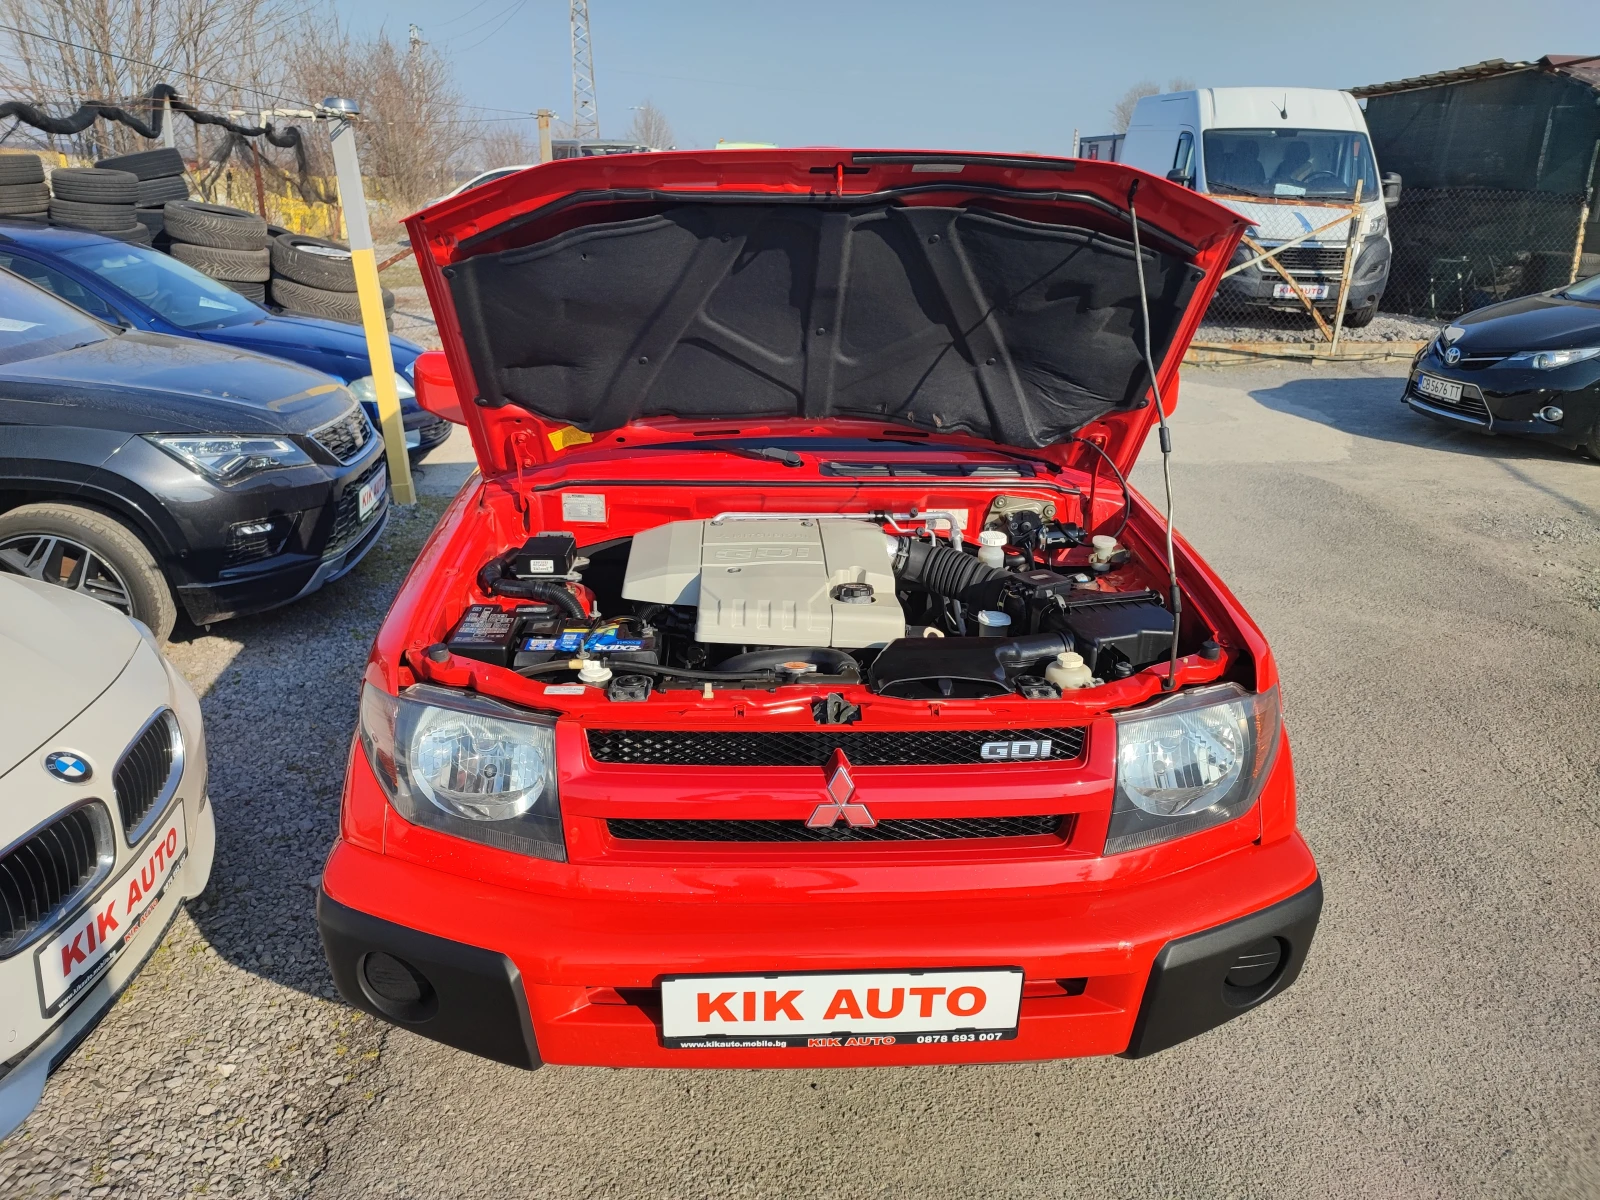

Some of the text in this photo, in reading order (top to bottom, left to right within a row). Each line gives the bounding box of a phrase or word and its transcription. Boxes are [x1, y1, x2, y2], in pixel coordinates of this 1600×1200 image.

[1421, 377, 1431, 391] CB
[1430, 380, 1448, 396] 5676
[1449, 384, 1461, 399] TT
[715, 546, 810, 560] GDI
[981, 740, 1052, 759] GDI
[60, 899, 119, 978] KIK
[126, 827, 177, 916] AUTO
[697, 986, 988, 1022] KIK AUTO
[680, 1040, 787, 1048] www.kikauto.mobile.bg
[807, 1035, 897, 1048] KIK AUTO
[916, 1032, 1003, 1044] 0878 693 007
